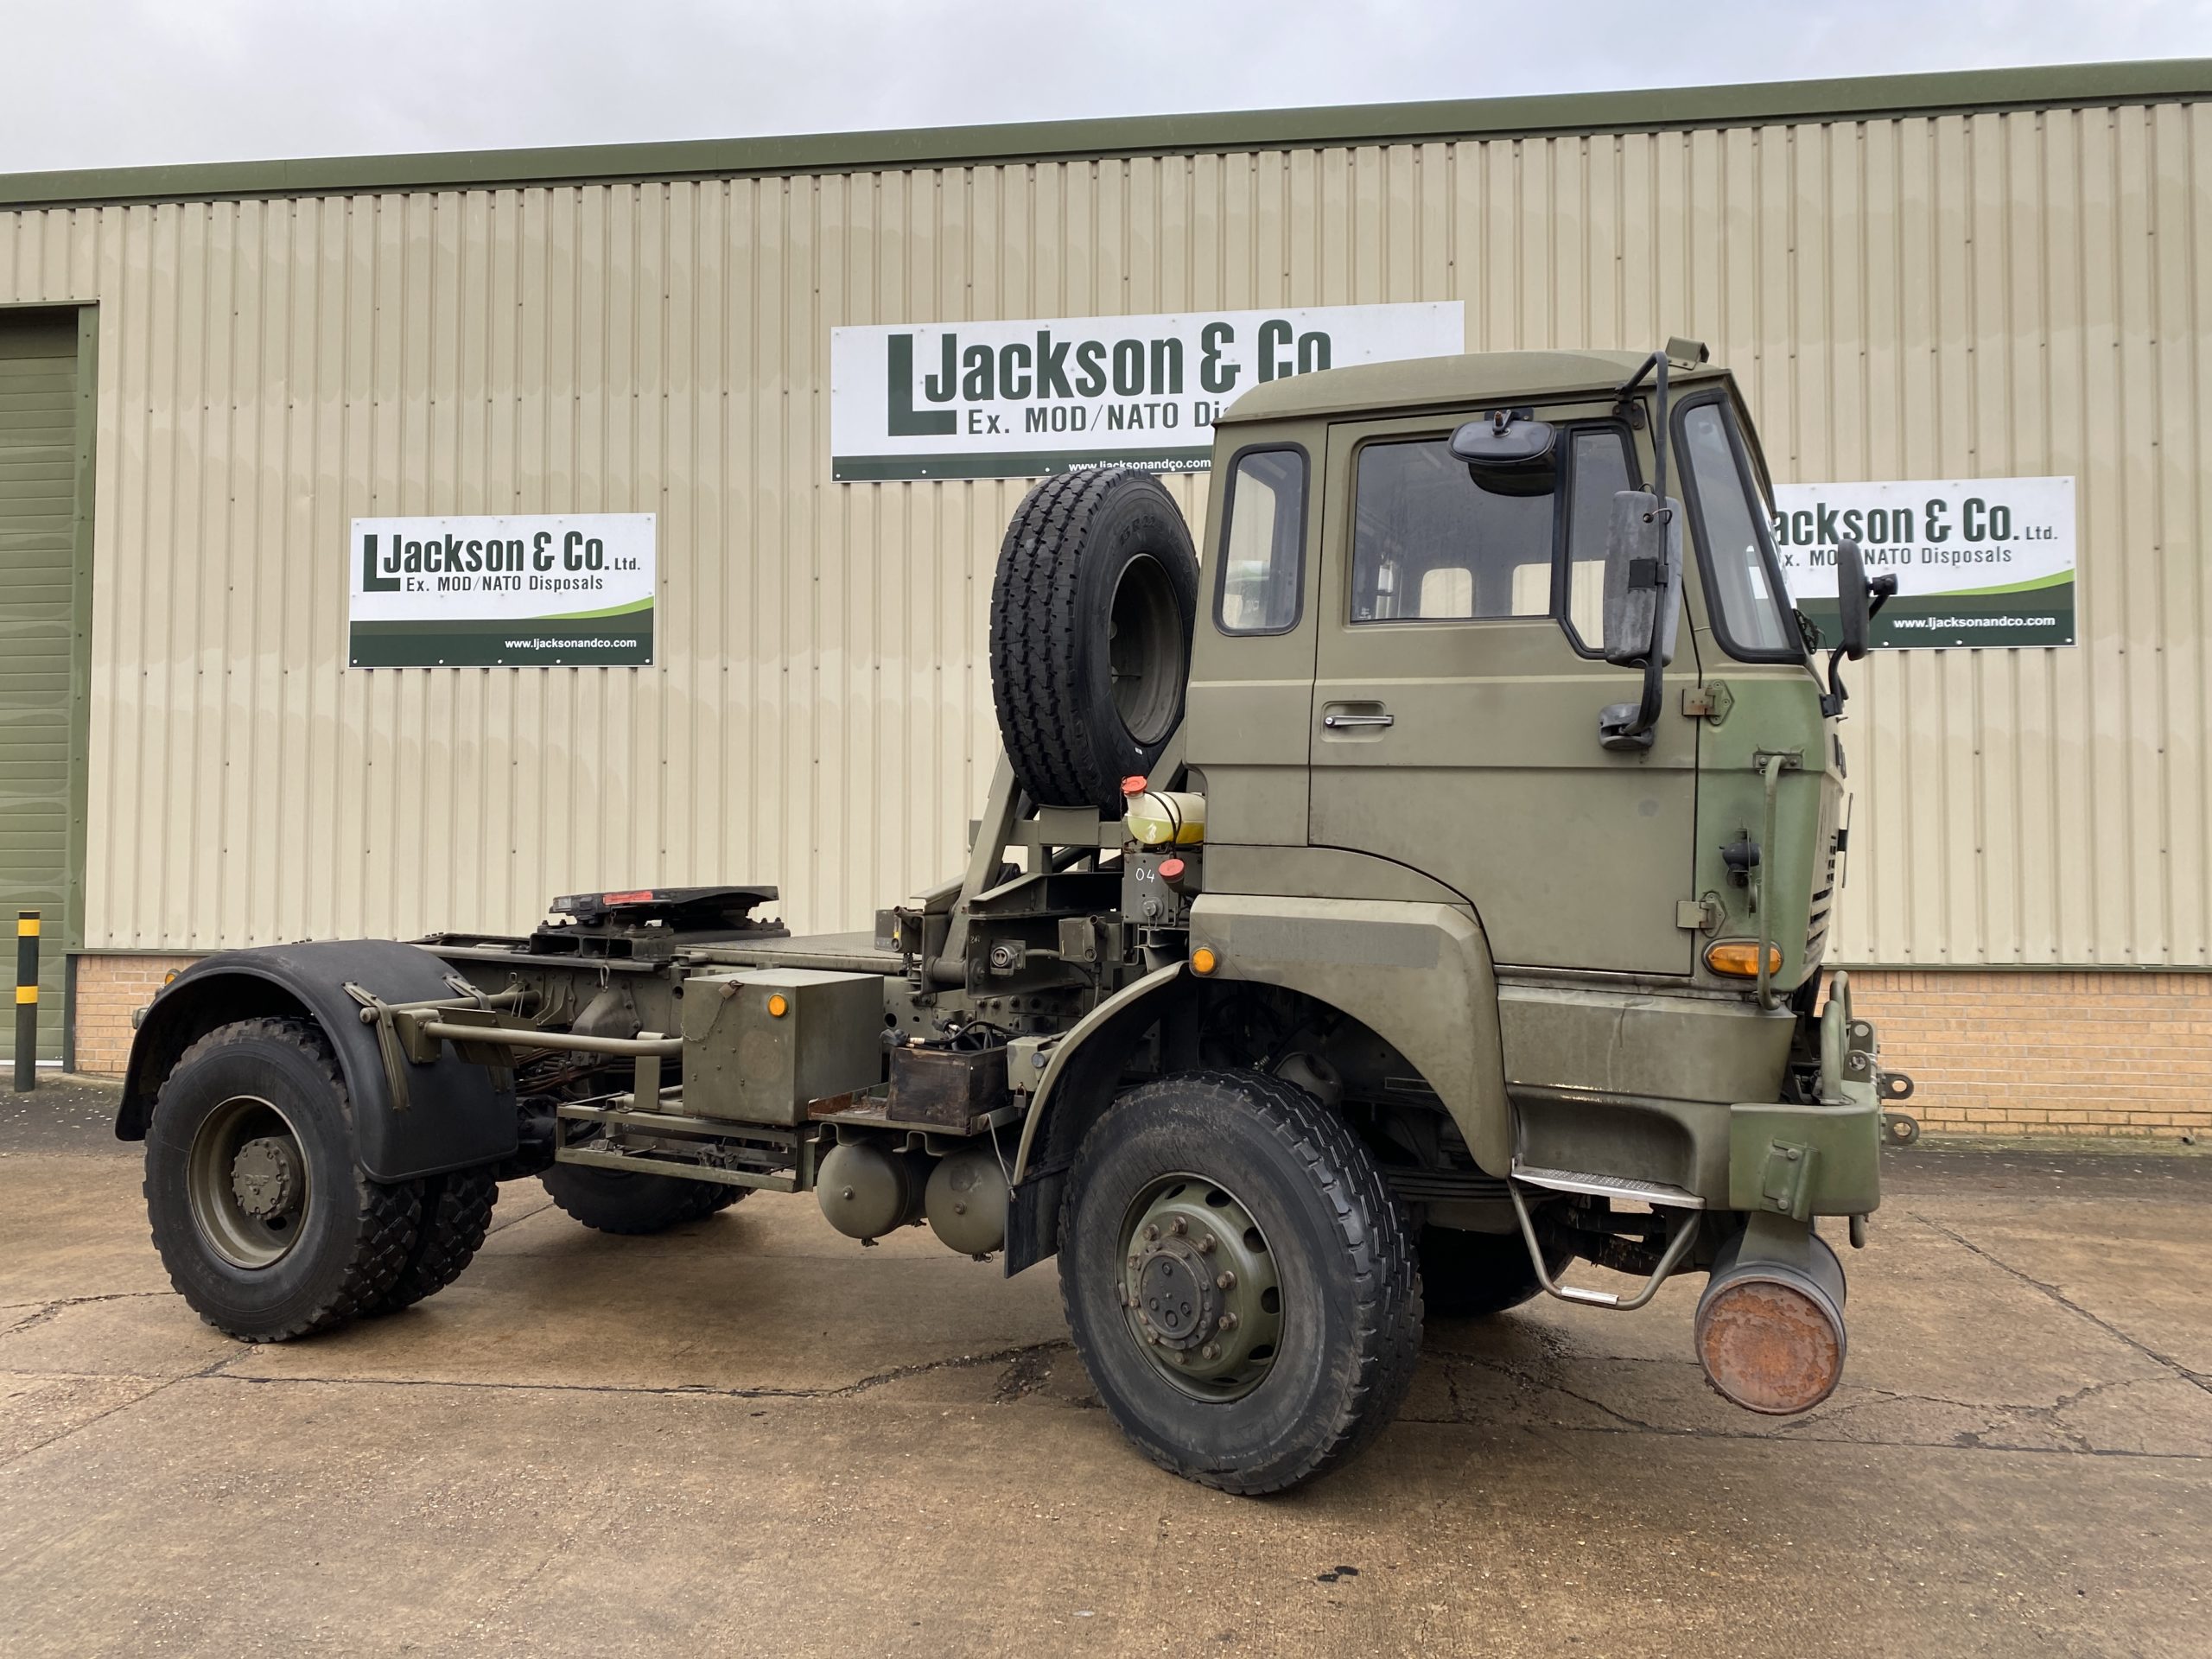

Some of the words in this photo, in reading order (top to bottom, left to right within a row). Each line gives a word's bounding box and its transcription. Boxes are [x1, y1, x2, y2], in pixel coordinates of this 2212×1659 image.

[1200, 321, 1242, 394] &
[968, 409, 1010, 435] Ex.
[1025, 402, 1179, 434] MOD/NATO
[1925, 499, 1952, 543] &
[1962, 497, 2019, 543] Co.
[2025, 525, 2058, 541] Ltd.
[532, 531, 556, 572] &
[563, 531, 610, 572] Co.
[614, 557, 641, 571] Ltd.
[1809, 547, 1912, 567] MONATO
[1922, 545, 2012, 567] Disposals
[406, 576, 430, 592] Ex.
[437, 575, 521, 592] MOD/NATO
[529, 574, 604, 594] Disposals
[1893, 615, 2056, 632] www.ljacksonandco.com
[505, 637, 637, 651] www.ljacksonandco.com
[1135, 868, 1155, 883] 04
